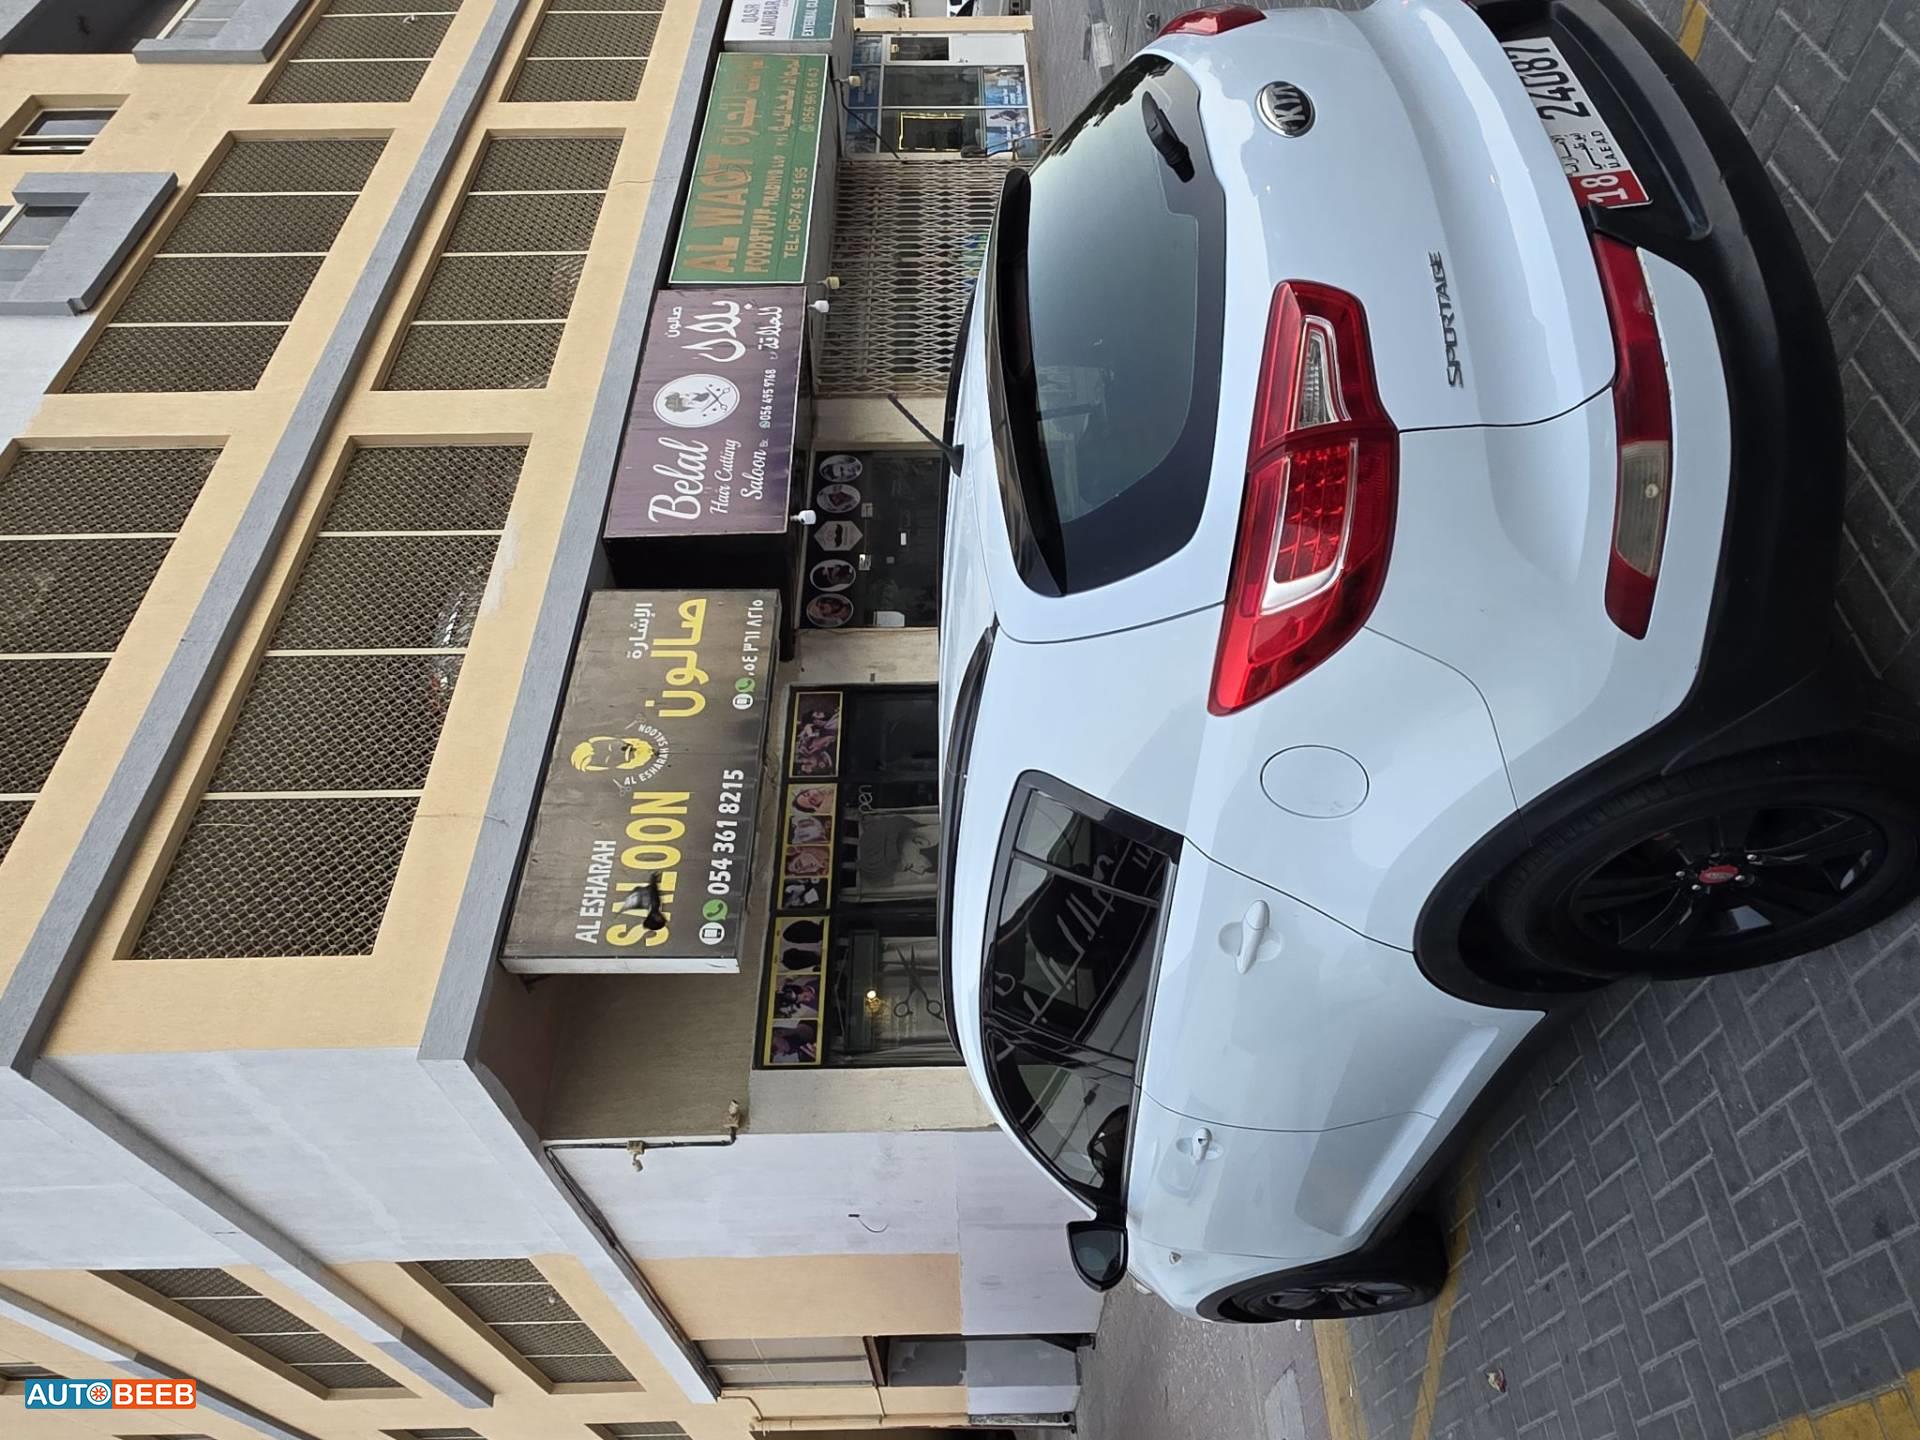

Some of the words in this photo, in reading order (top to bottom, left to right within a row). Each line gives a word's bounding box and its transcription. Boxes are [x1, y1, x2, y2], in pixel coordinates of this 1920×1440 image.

[758, 0, 781, 36] ALMUBAR
[1502, 45, 1591, 121] 24087
[690, 154, 753, 230] WAQT
[1580, 174, 1630, 203] 18
[787, 202, 804, 231] 06-74
[681, 236, 740, 273] AL
[743, 208, 777, 272] FOODSTUFF
[783, 233, 800, 258] TEL:
[664, 306, 683, 338] صالون
[1426, 248, 1465, 389] SPORTAGE
[763, 368, 777, 387] 9768
[759, 405, 773, 421] 056
[762, 389, 775, 404] 495
[714, 439, 741, 482] Cutting
[740, 449, 768, 500] Saloon
[648, 437, 709, 523] Belal
[709, 483, 731, 514] Hair
[626, 603, 656, 659] الإشارة
[644, 598, 709, 717] صالون
[638, 723, 668, 747] SALOON
[623, 775, 637, 785] AL
[638, 748, 670, 782] ESHARAH
[718, 769, 744, 815] 8215
[712, 820, 738, 853] 361
[579, 840, 617, 917] ESHARAH
[605, 791, 691, 947] SALOON
[707, 858, 732, 895] 054
[575, 920, 601, 944] AL
